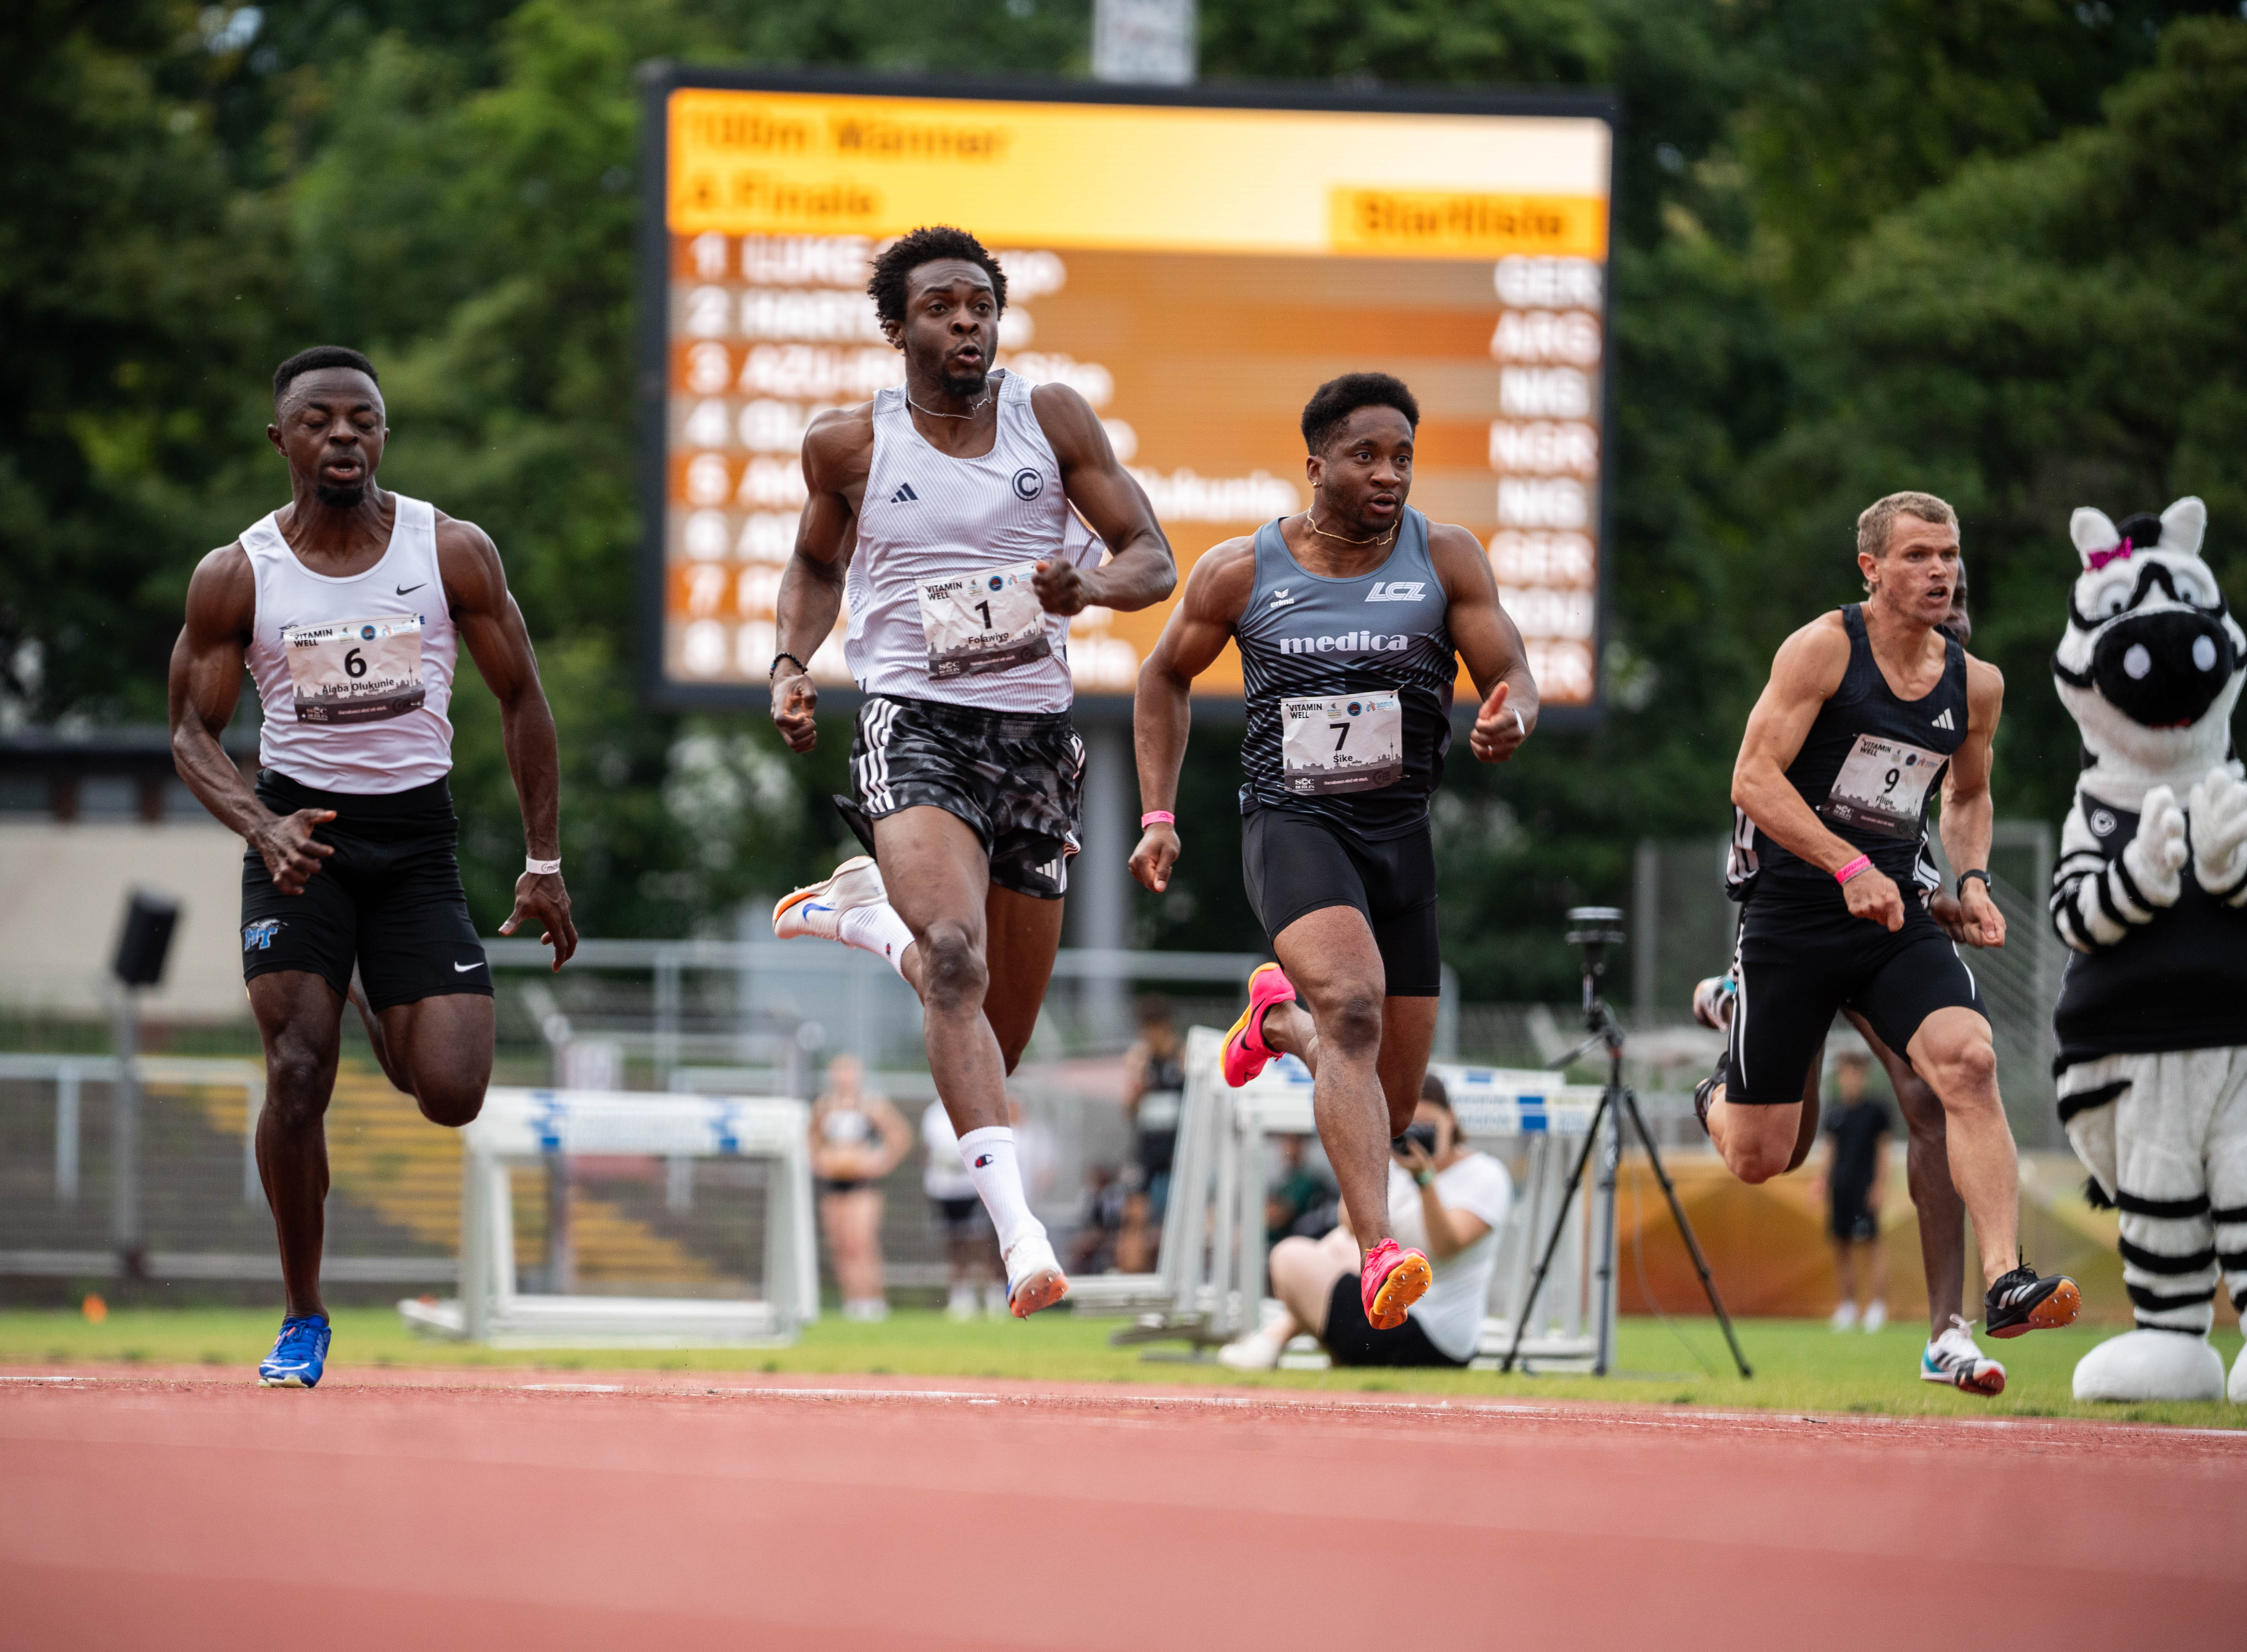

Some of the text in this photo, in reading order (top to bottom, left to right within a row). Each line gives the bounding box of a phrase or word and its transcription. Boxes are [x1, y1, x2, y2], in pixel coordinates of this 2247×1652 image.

[926, 582, 962, 593] VITAMIN
[1365, 581, 1425, 602] LCZ
[927, 591, 949, 601] WELL
[1270, 597, 1294, 608] erima
[974, 600, 992, 630] 1
[293, 629, 333, 640] VITAMIN
[968, 632, 1009, 644] Folawiyo
[294, 639, 318, 648] WELL
[1280, 630, 1408, 655] medica
[345, 648, 367, 678] 6
[322, 679, 394, 694] Alaba Olukunle
[1289, 704, 1322, 712] VITAMIN
[1330, 722, 1350, 751] 7
[1860, 746, 1878, 757] WELL
[1863, 739, 1892, 753] VITAMIN
[1333, 754, 1353, 763] Sike
[1884, 769, 1900, 794] 9
[1876, 796, 1894, 806] Filipe
[244, 927, 279, 951] MT
